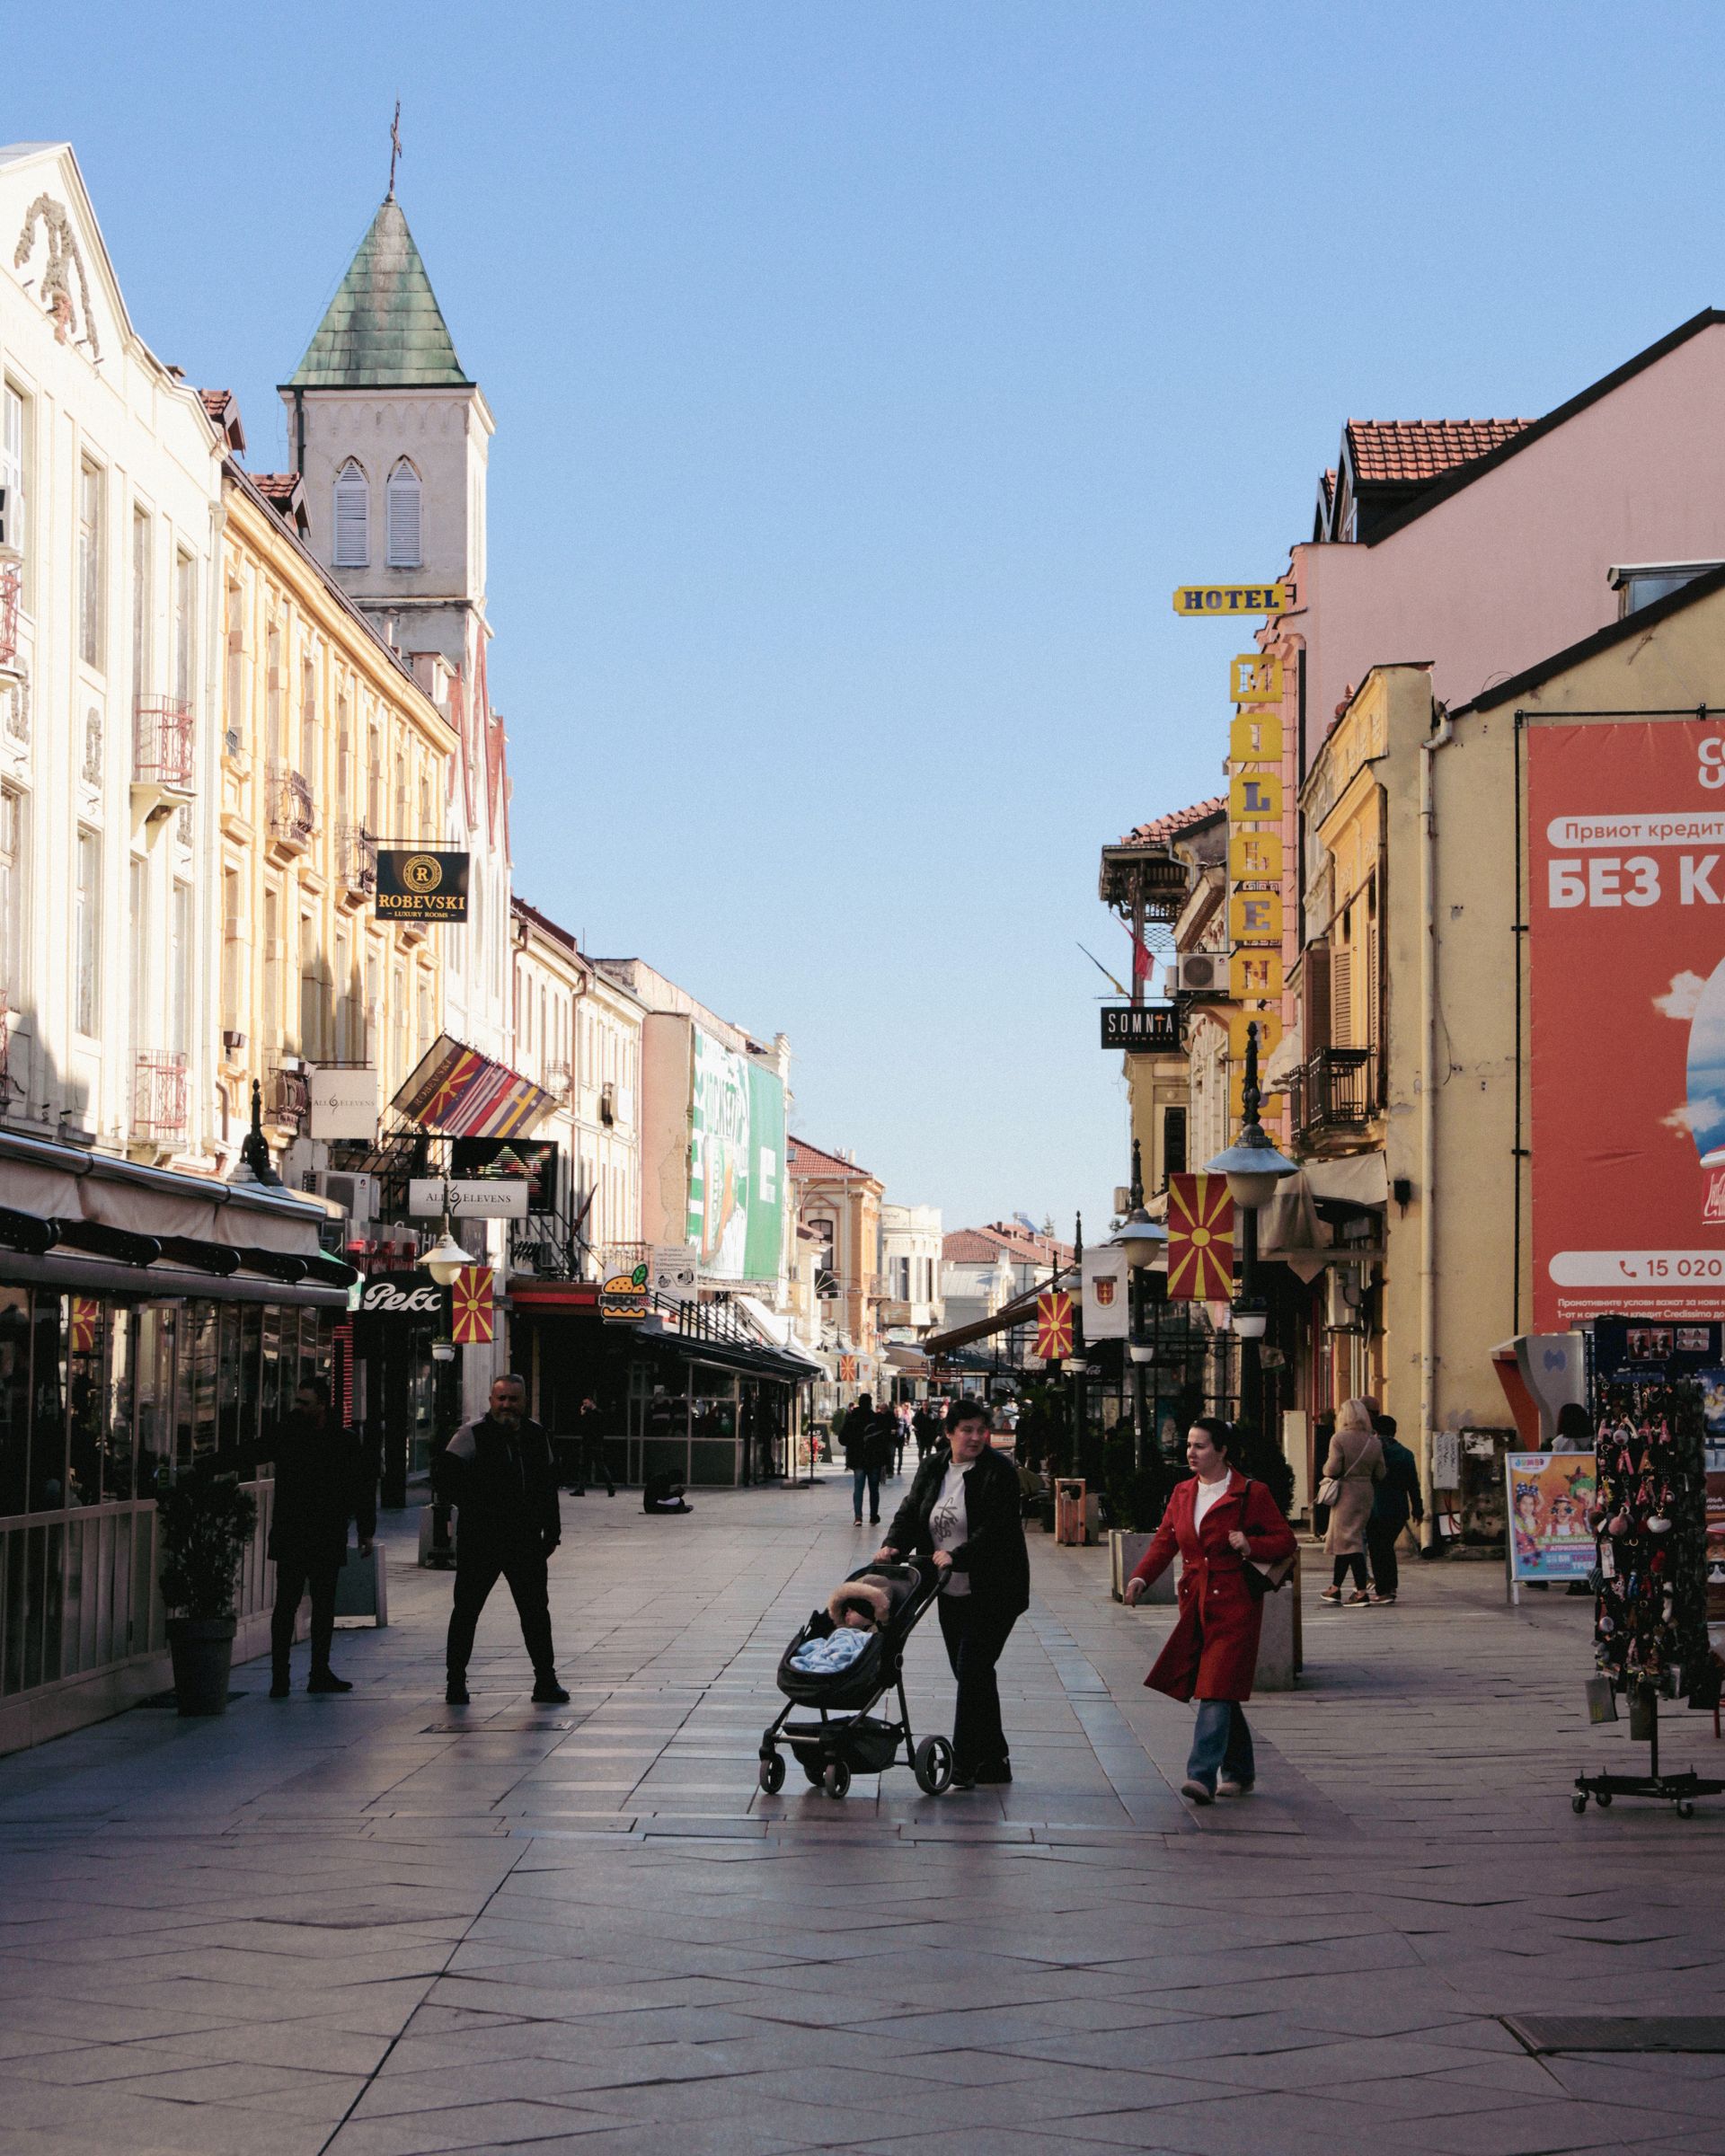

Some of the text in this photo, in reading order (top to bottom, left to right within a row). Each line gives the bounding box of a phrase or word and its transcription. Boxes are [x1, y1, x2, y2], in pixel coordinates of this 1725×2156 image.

[1184, 590, 1279, 609] HOTEL
[1565, 822, 1724, 844] Првиот кредит
[416, 867, 429, 881] R
[1548, 855, 1725, 908] БЕЗ К
[378, 894, 465, 910] ROBEVSKI
[415, 1058, 453, 1107] ROBEVSKI
[463, 1193, 511, 1203] ELEVENS
[1647, 1259, 1721, 1277] 15 020
[1623, 1299, 1654, 1308] услови
[1664, 1309, 1712, 1319] Credissimo
